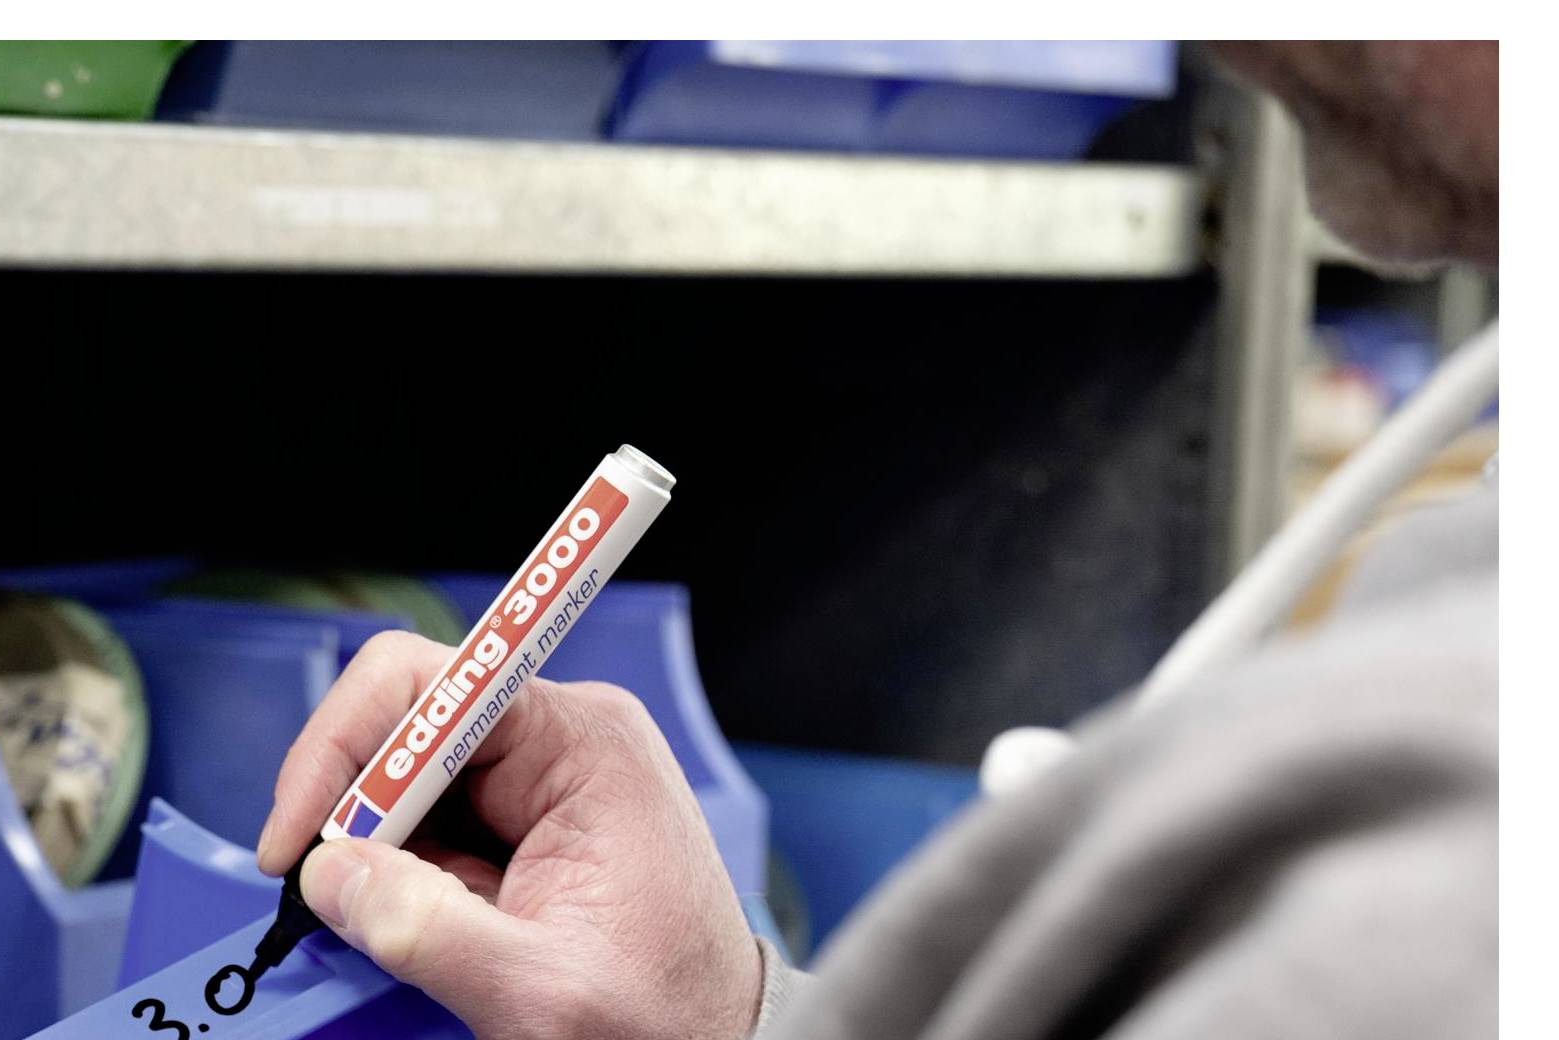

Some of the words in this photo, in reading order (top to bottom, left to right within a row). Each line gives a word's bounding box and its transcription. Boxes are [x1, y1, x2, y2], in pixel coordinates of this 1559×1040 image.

[503, 507, 600, 625] 3000
[442, 651, 536, 778] permanent
[537, 568, 600, 653] marker
